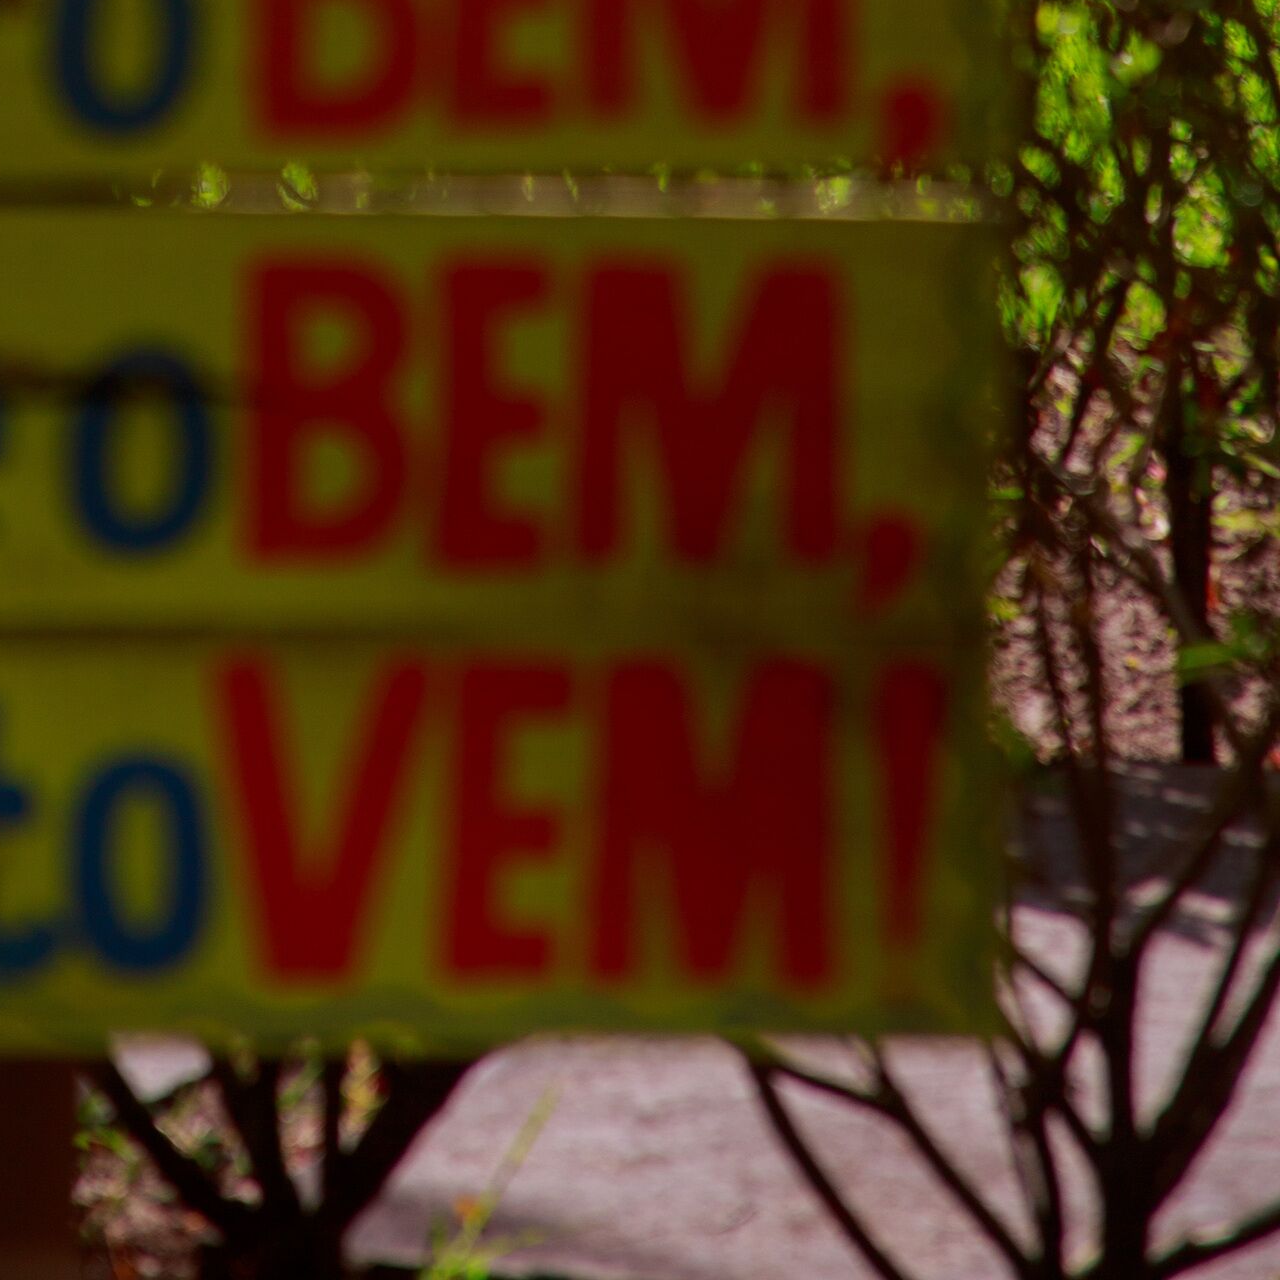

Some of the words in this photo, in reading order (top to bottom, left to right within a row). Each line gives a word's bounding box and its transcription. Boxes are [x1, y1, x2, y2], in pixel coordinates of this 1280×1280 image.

[63, 343, 215, 561] o
[240, 256, 931, 611] BEM,
[205, 652, 947, 992] VEM!
